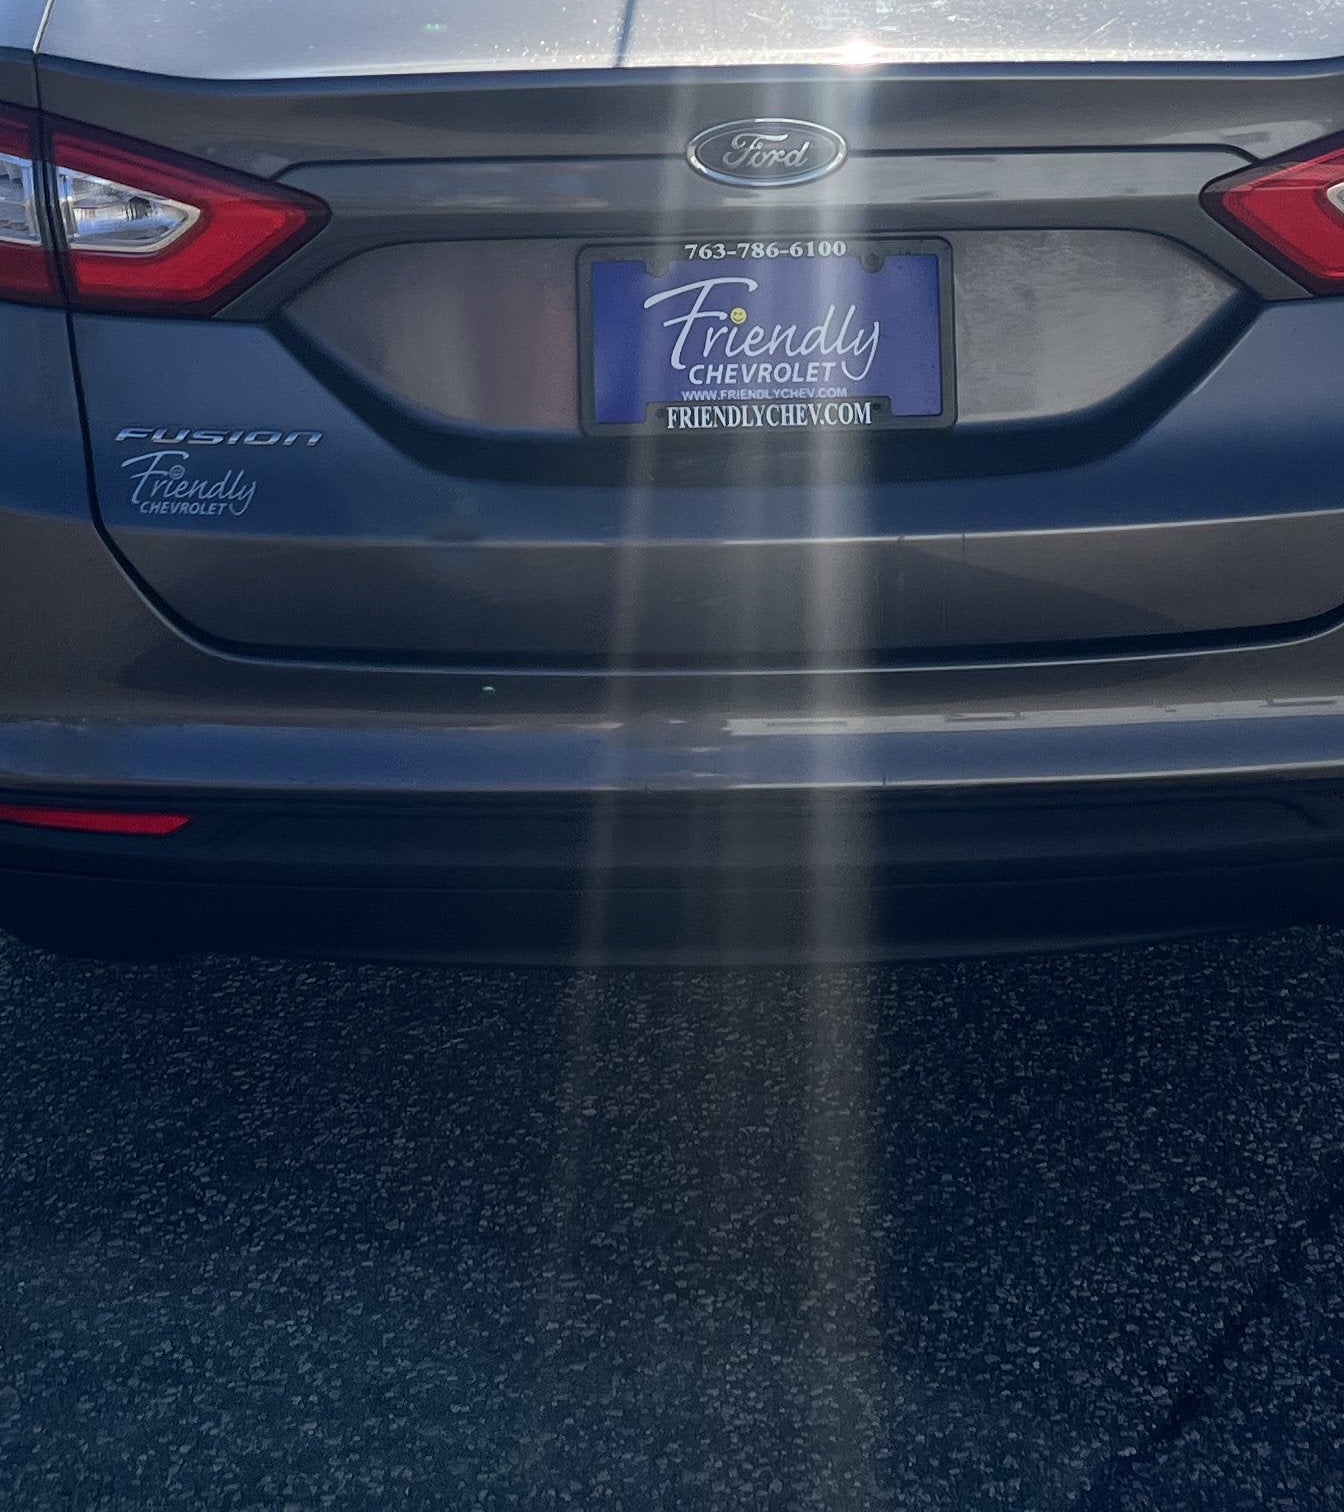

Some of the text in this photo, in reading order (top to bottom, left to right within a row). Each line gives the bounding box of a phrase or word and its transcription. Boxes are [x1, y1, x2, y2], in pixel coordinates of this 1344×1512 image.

[722, 133, 811, 169] Ford
[684, 240, 847, 260] 763-786-6100
[643, 277, 881, 381] Friendly
[688, 361, 837, 386] CHEVROLET
[681, 387, 849, 401] WWW.FRIENDLYCHEV.COM
[666, 402, 873, 430] FRIENDLYCHEV.COM
[115, 427, 324, 447] FUSION
[121, 449, 257, 516] Friendly
[139, 501, 229, 515] CHEVROLET
